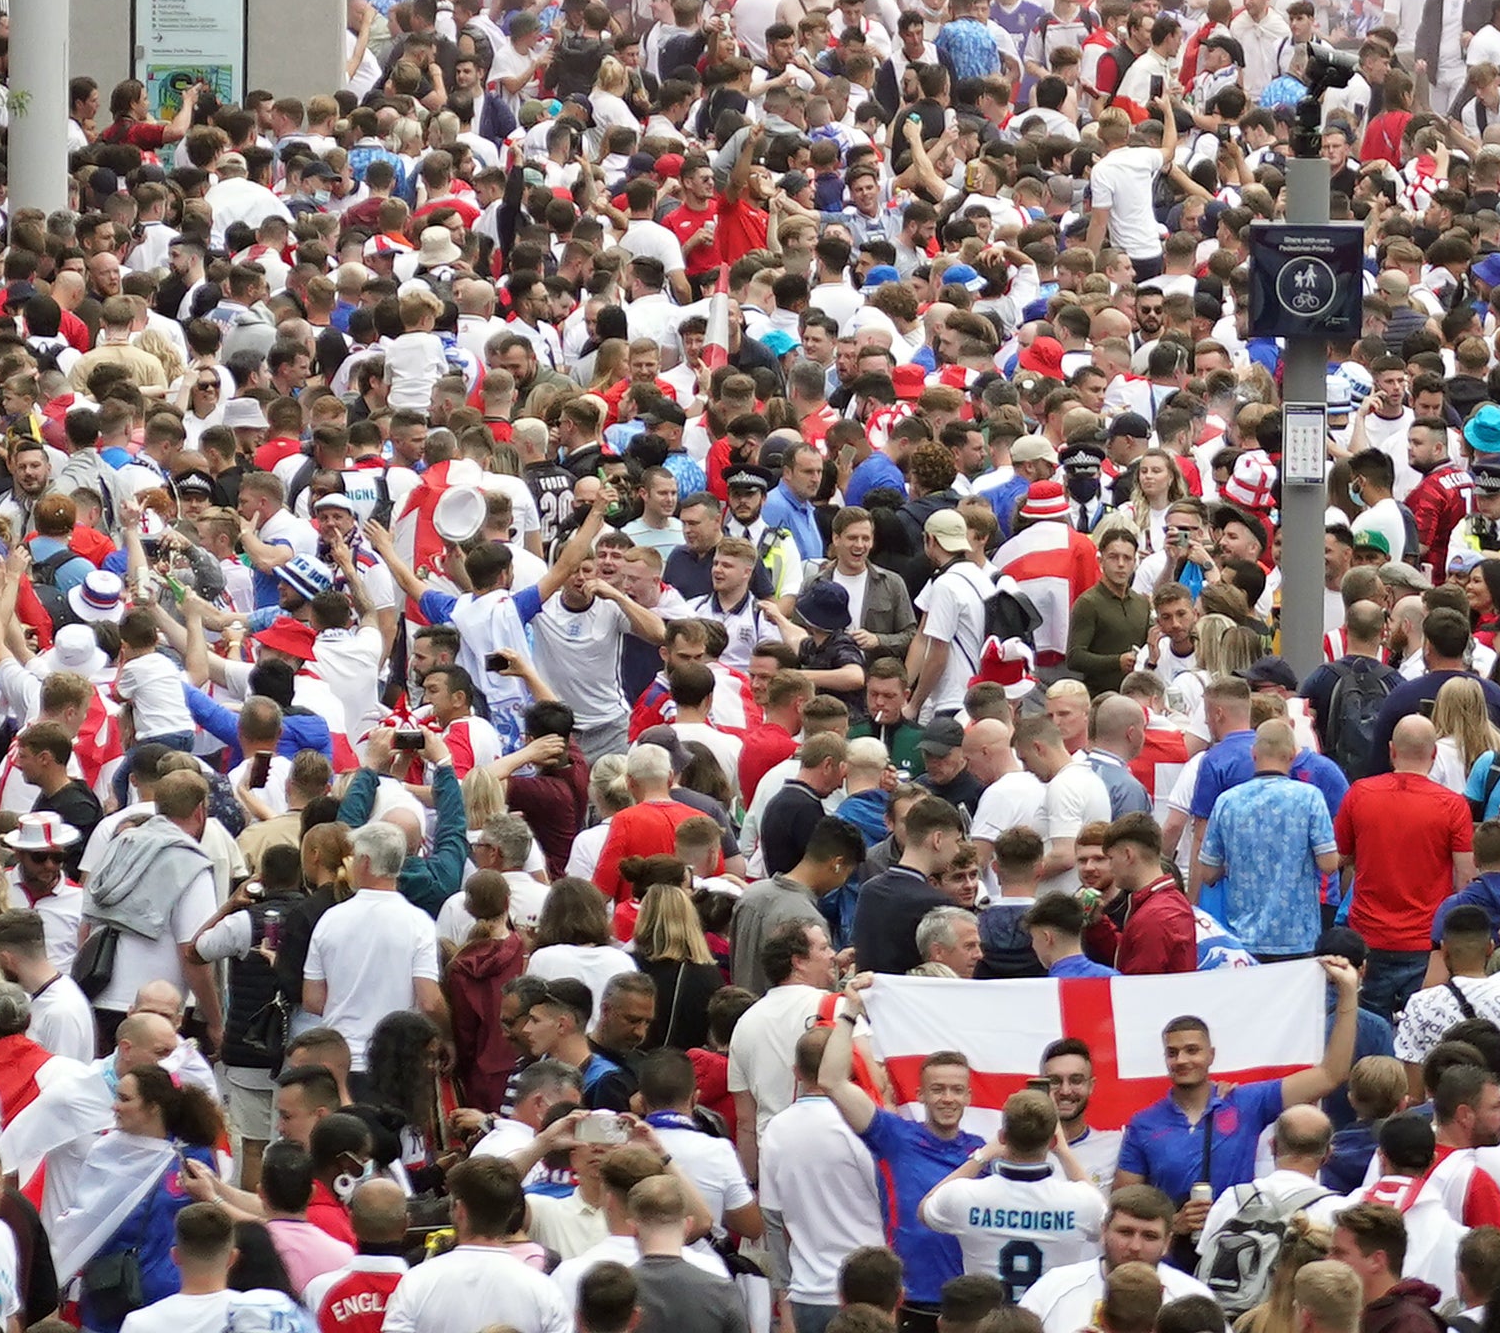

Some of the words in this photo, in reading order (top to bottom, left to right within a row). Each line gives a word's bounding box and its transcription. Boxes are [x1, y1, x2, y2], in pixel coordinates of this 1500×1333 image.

[969, 1206, 1076, 1230] GASCOIGNE
[999, 1239, 1043, 1306] 8
[331, 1291, 386, 1323] ENGL
